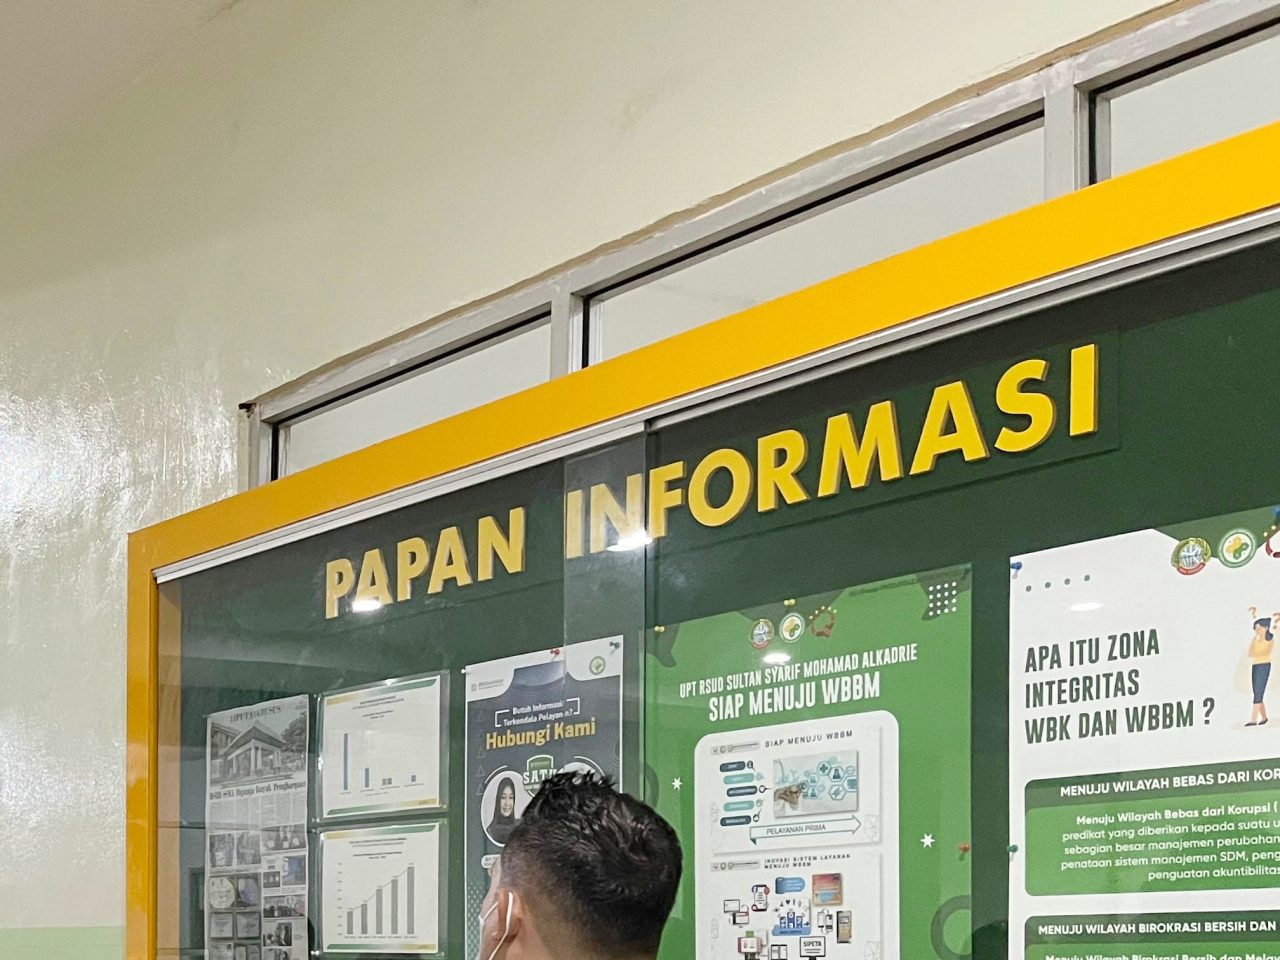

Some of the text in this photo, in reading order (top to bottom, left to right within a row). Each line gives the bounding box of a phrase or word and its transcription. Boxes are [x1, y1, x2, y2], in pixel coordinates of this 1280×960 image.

[324, 344, 1100, 619] PAPAN INFORMASI
[1025, 629, 1160, 673] APA ITU ZONA
[679, 643, 917, 698] UPT RSUD SULTAN SYARIF MOHAMAD ALKADRIE
[709, 671, 880, 722] SIAP MENUJU WBBM
[1025, 669, 1140, 709] INTEGRITAS
[503, 715, 538, 727] Terkendala
[512, 706, 532, 715] Butuh
[1025, 697, 1216, 745] WBK DAN WBBM ?
[485, 717, 596, 750] Hubungi Kami
[765, 730, 853, 748] SIAP MENUJU WBBM
[1060, 782, 1109, 797] MENUJU
[1113, 778, 1169, 793] WILAYAH
[1173, 774, 1214, 788] BEBAS
[1217, 770, 1250, 784] DARI
[1076, 814, 1115, 826] Menuju
[1117, 811, 1161, 824] Wilayah
[1164, 808, 1199, 820] Bebas
[1202, 805, 1225, 817] dari
[1227, 802, 1271, 816] Korupsi
[766, 823, 826, 835] PELAYANAN PRIMA
[1062, 829, 1106, 843] predikat
[1108, 828, 1135, 841] yang
[1138, 824, 1189, 837] diberikan
[1191, 821, 1235, 835] kepada
[1237, 819, 1271, 831] suatu
[1064, 843, 1113, 856] sebagian
[1115, 841, 1146, 852] besar
[1148, 838, 1214, 852] manajemen
[1060, 859, 1112, 872] penataan
[1115, 857, 1149, 868] sistem
[1151, 853, 1217, 868] manajemen
[1220, 850, 1250, 862] SDM,
[1148, 869, 1210, 882] penguatan
[1038, 921, 1277, 935] MENUJU WILAYAH BIROKRASI BERSIH DAN
